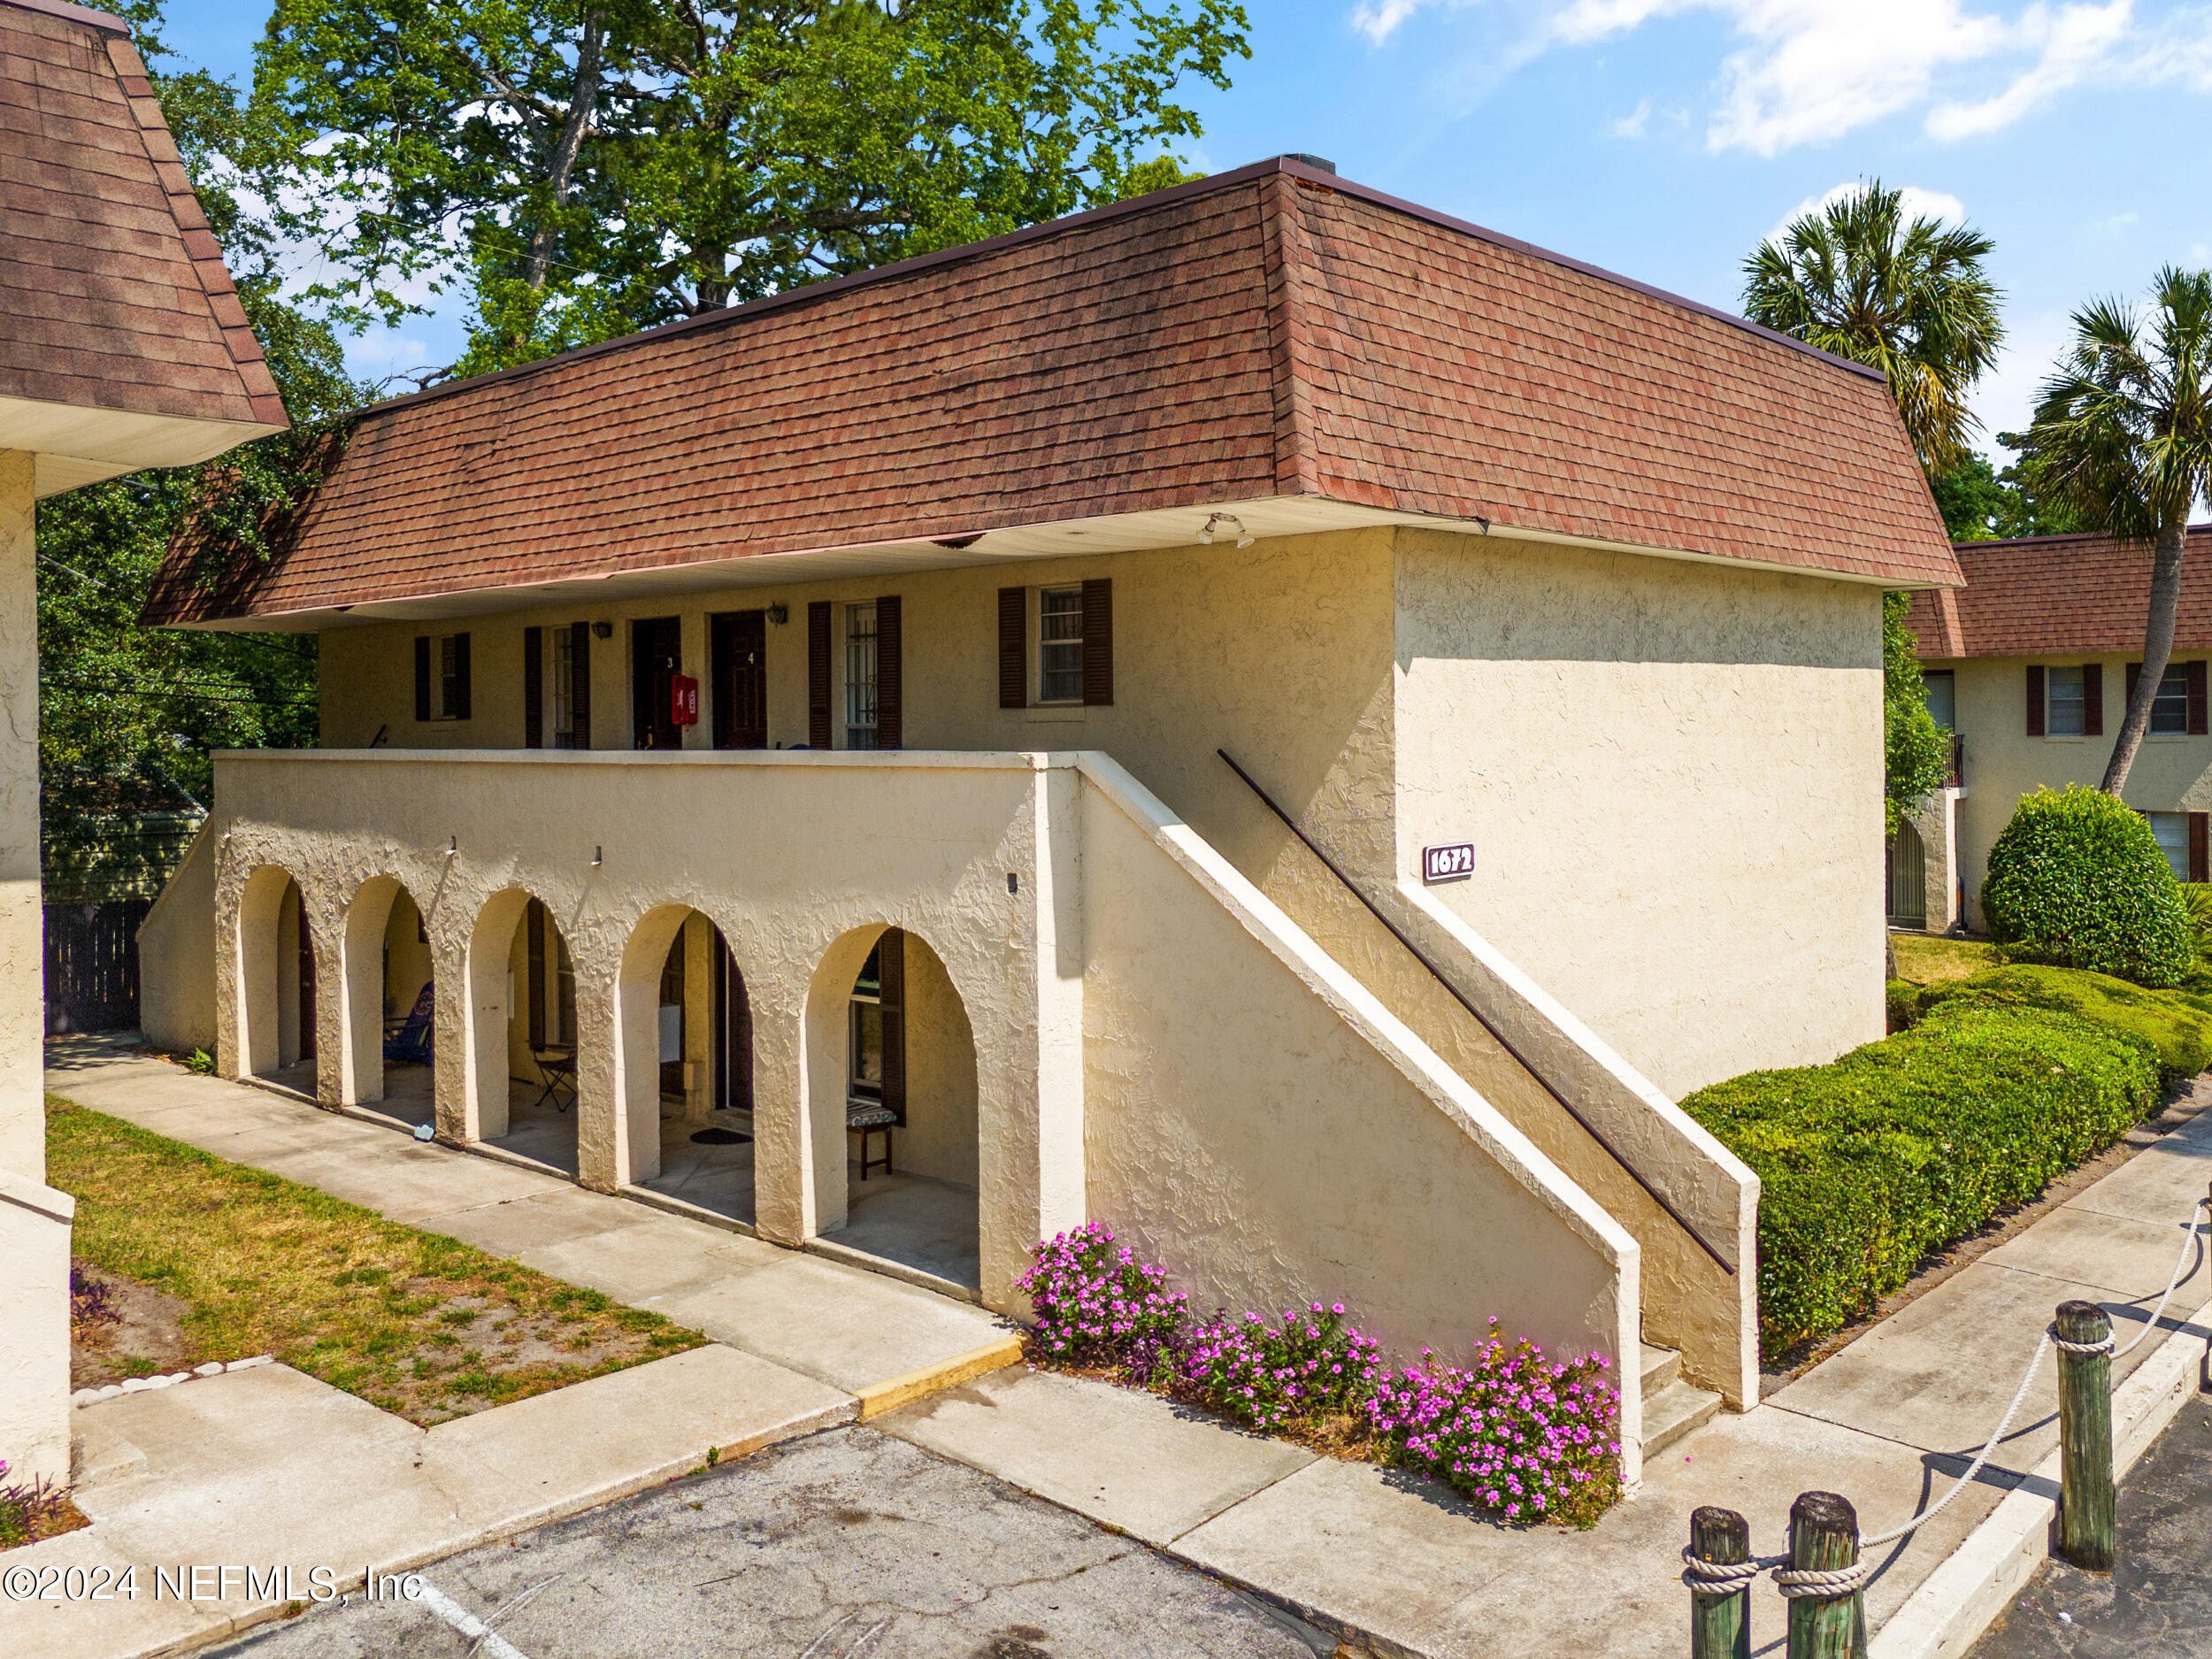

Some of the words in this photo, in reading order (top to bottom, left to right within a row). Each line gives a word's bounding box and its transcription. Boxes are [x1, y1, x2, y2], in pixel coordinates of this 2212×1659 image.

[667, 657, 673, 668] 3
[748, 652, 755, 664] 4
[1431, 847, 1472, 874] 1672
